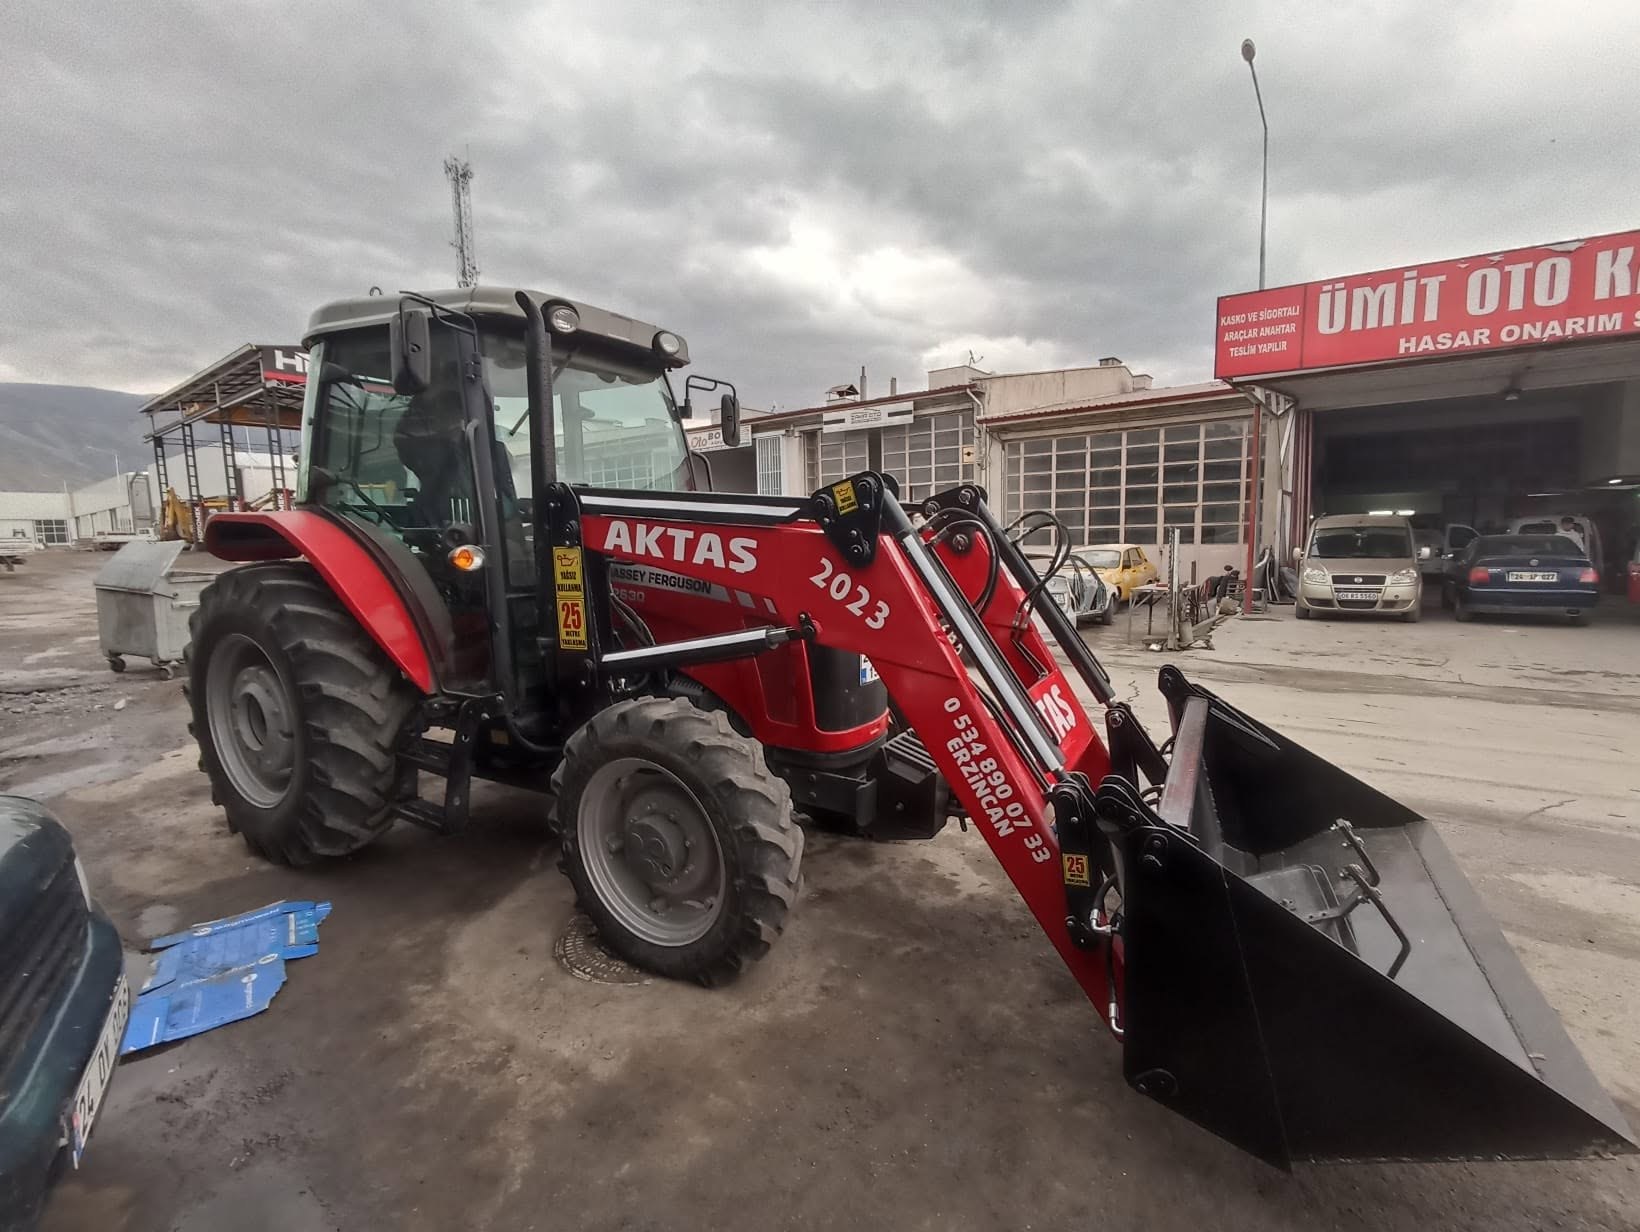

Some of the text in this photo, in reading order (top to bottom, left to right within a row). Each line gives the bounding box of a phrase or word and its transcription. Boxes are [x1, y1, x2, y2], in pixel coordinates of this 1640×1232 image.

[1318, 270, 1447, 335] ÜMİT
[1466, 256, 1571, 316] OTO
[1220, 305, 1300, 327] KASKO VE SİGORTALI
[1224, 323, 1296, 343] ARAÇLAR ANAHTAR
[1398, 327, 1491, 354] HASAR
[1499, 312, 1623, 342] ONARIM
[1229, 341, 1287, 358] TESLİM YAPILIR
[612, 566, 712, 594] ASSEY FERGUSON
[809, 557, 890, 629] 2023
[561, 602, 582, 630] 25
[943, 697, 1051, 863] 0 534 890 07 33
[1066, 856, 1085, 874] 25
